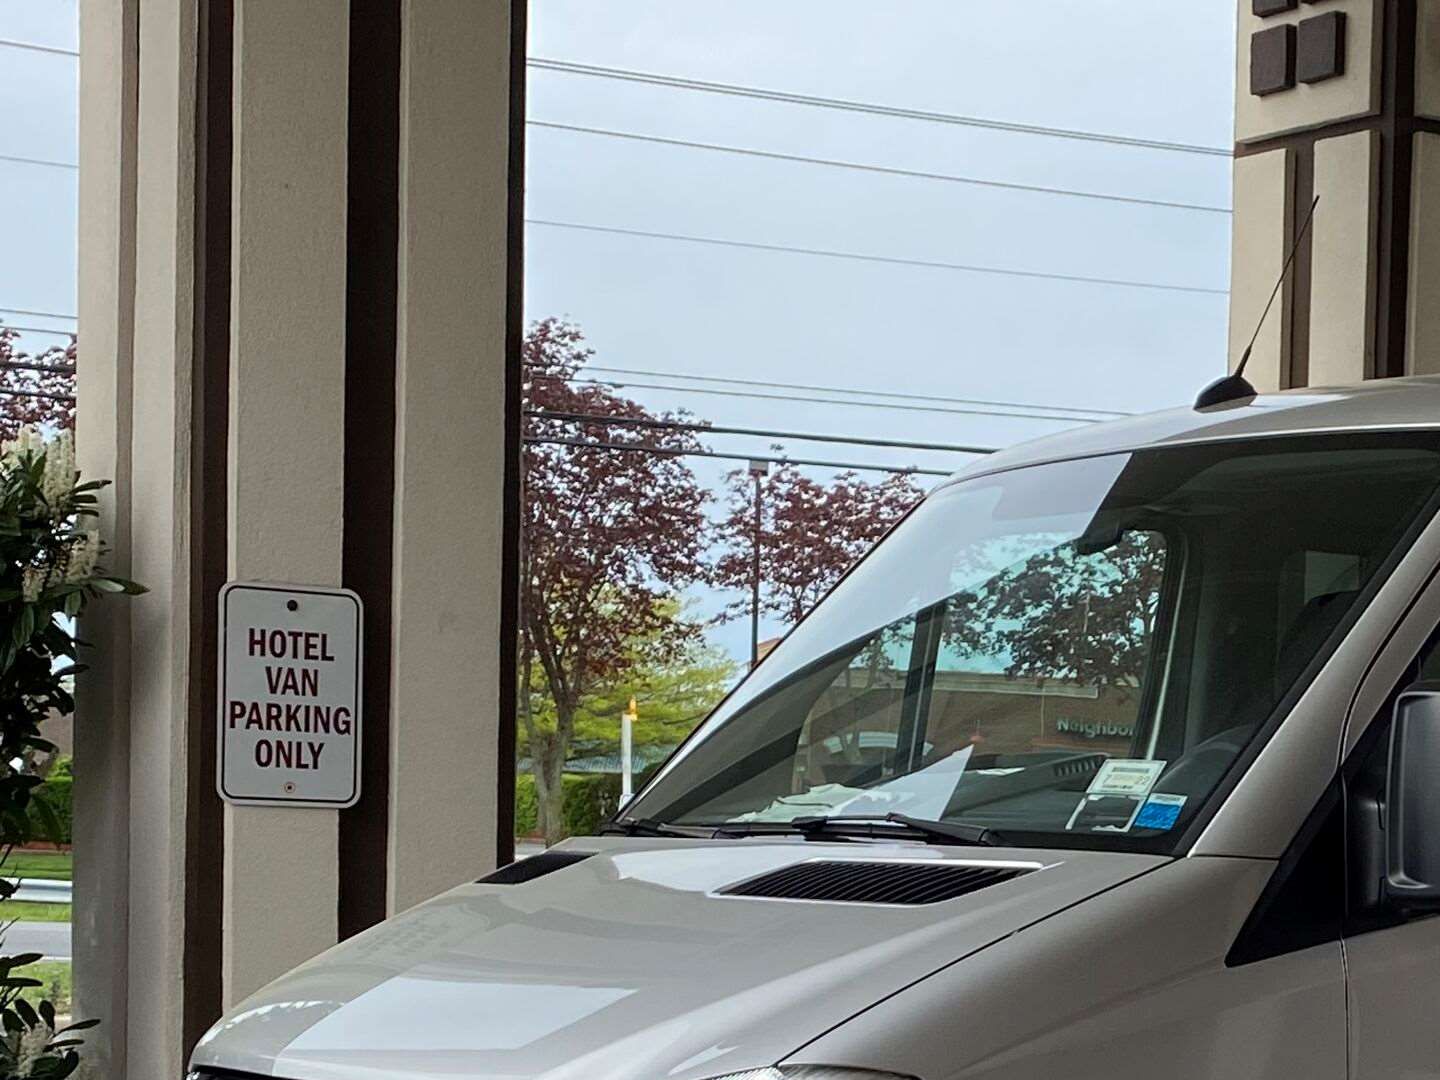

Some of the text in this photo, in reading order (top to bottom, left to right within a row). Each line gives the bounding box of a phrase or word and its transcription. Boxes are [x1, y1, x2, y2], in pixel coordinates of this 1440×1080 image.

[248, 627, 335, 662] HOTEL
[265, 665, 319, 697] VAN
[229, 700, 352, 736] PARKING
[254, 738, 325, 770] ONLY
